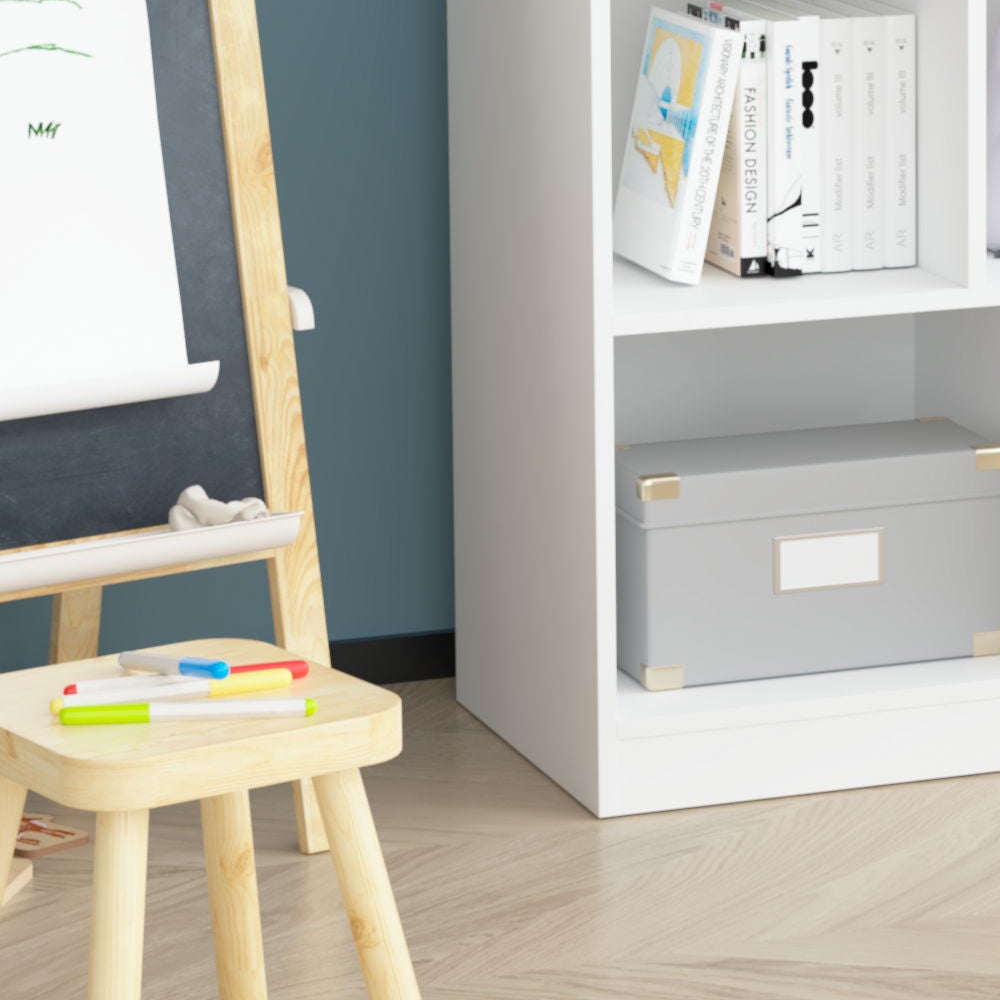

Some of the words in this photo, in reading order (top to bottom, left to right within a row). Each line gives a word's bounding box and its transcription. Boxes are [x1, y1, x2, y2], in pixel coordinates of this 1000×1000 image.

[834, 85, 843, 118] volume
[866, 83, 875, 116] volume
[898, 80, 906, 114] volume
[744, 88, 756, 153] FASHION
[834, 158, 843, 171] list
[866, 155, 875, 169] list
[898, 154, 906, 167] list
[745, 159, 757, 213] DESIGN
[834, 174, 843, 210] Modifier
[866, 172, 875, 208] Modifier
[898, 168, 906, 206] Modifier
[832, 234, 843, 252] AR
[864, 231, 875, 250] AR
[896, 229, 906, 248] AR
